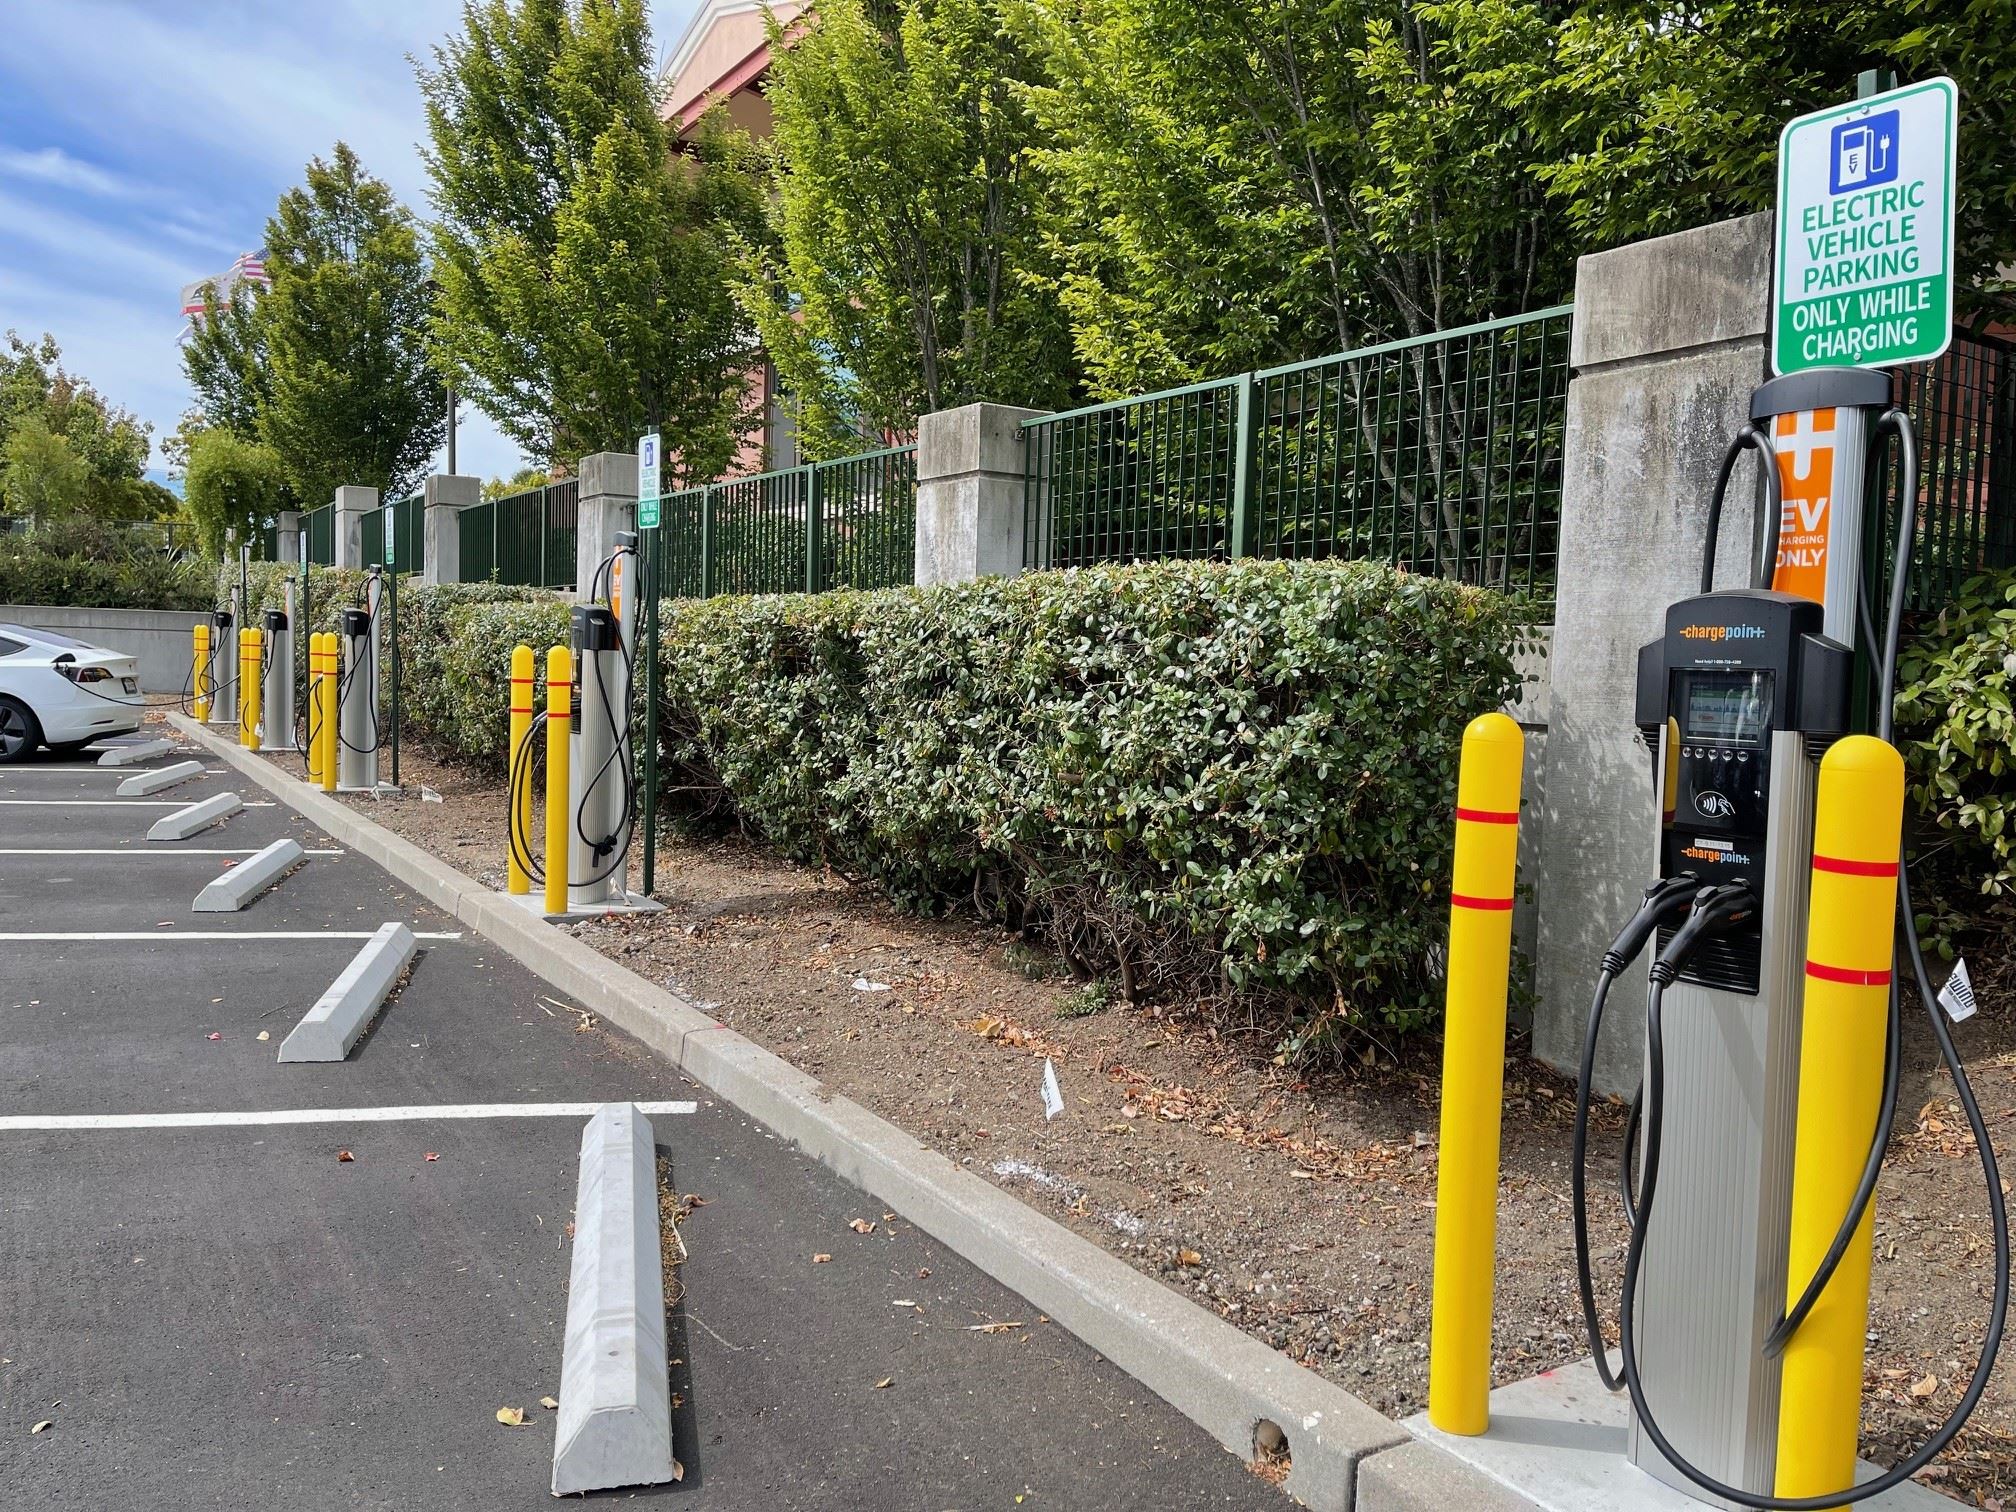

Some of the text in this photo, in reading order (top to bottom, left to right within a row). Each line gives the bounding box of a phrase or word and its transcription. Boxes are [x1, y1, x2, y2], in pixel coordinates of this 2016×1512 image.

[1802, 180, 1925, 233] ELECTRIC
[1807, 214, 1916, 261] VEHICLE
[1803, 246, 1919, 293] PARKING
[1792, 281, 1931, 332] ONLY WHILE
[1802, 317, 1918, 361] CHARGING
[1780, 497, 1828, 532] EV
[1779, 535, 1825, 545] HARGING
